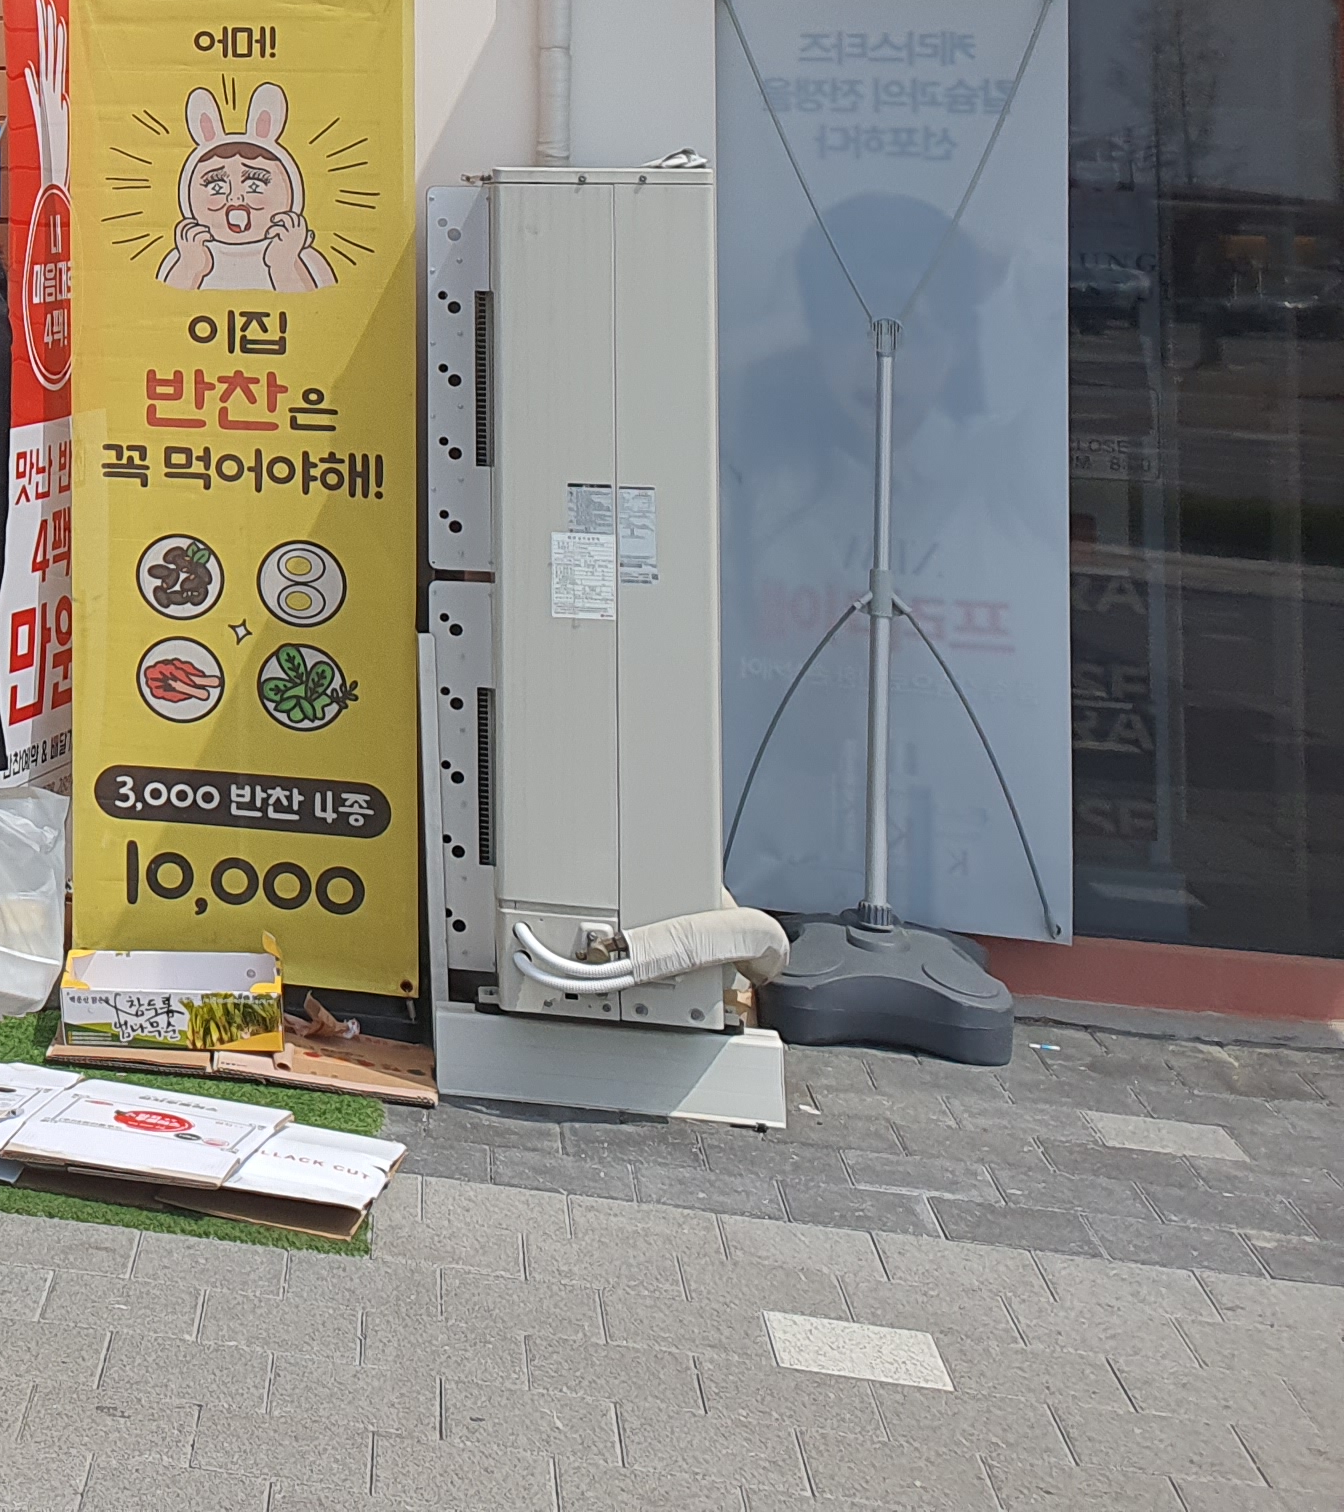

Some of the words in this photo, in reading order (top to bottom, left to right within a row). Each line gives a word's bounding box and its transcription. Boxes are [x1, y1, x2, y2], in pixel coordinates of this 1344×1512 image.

[194, 25, 278, 59] 어머!
[49, 214, 62, 254] 내
[32, 263, 72, 304] 마음대
[187, 310, 288, 355] 이집
[145, 368, 339, 432] 반찬은
[14, 445, 52, 506] 맛난
[101, 444, 150, 487] 꼭
[163, 447, 385, 500] 먹어야해!
[114, 775, 220, 812] 3,000
[230, 785, 305, 820] 반찬
[314, 791, 375, 828] 4종
[126, 839, 366, 916] 10,000
